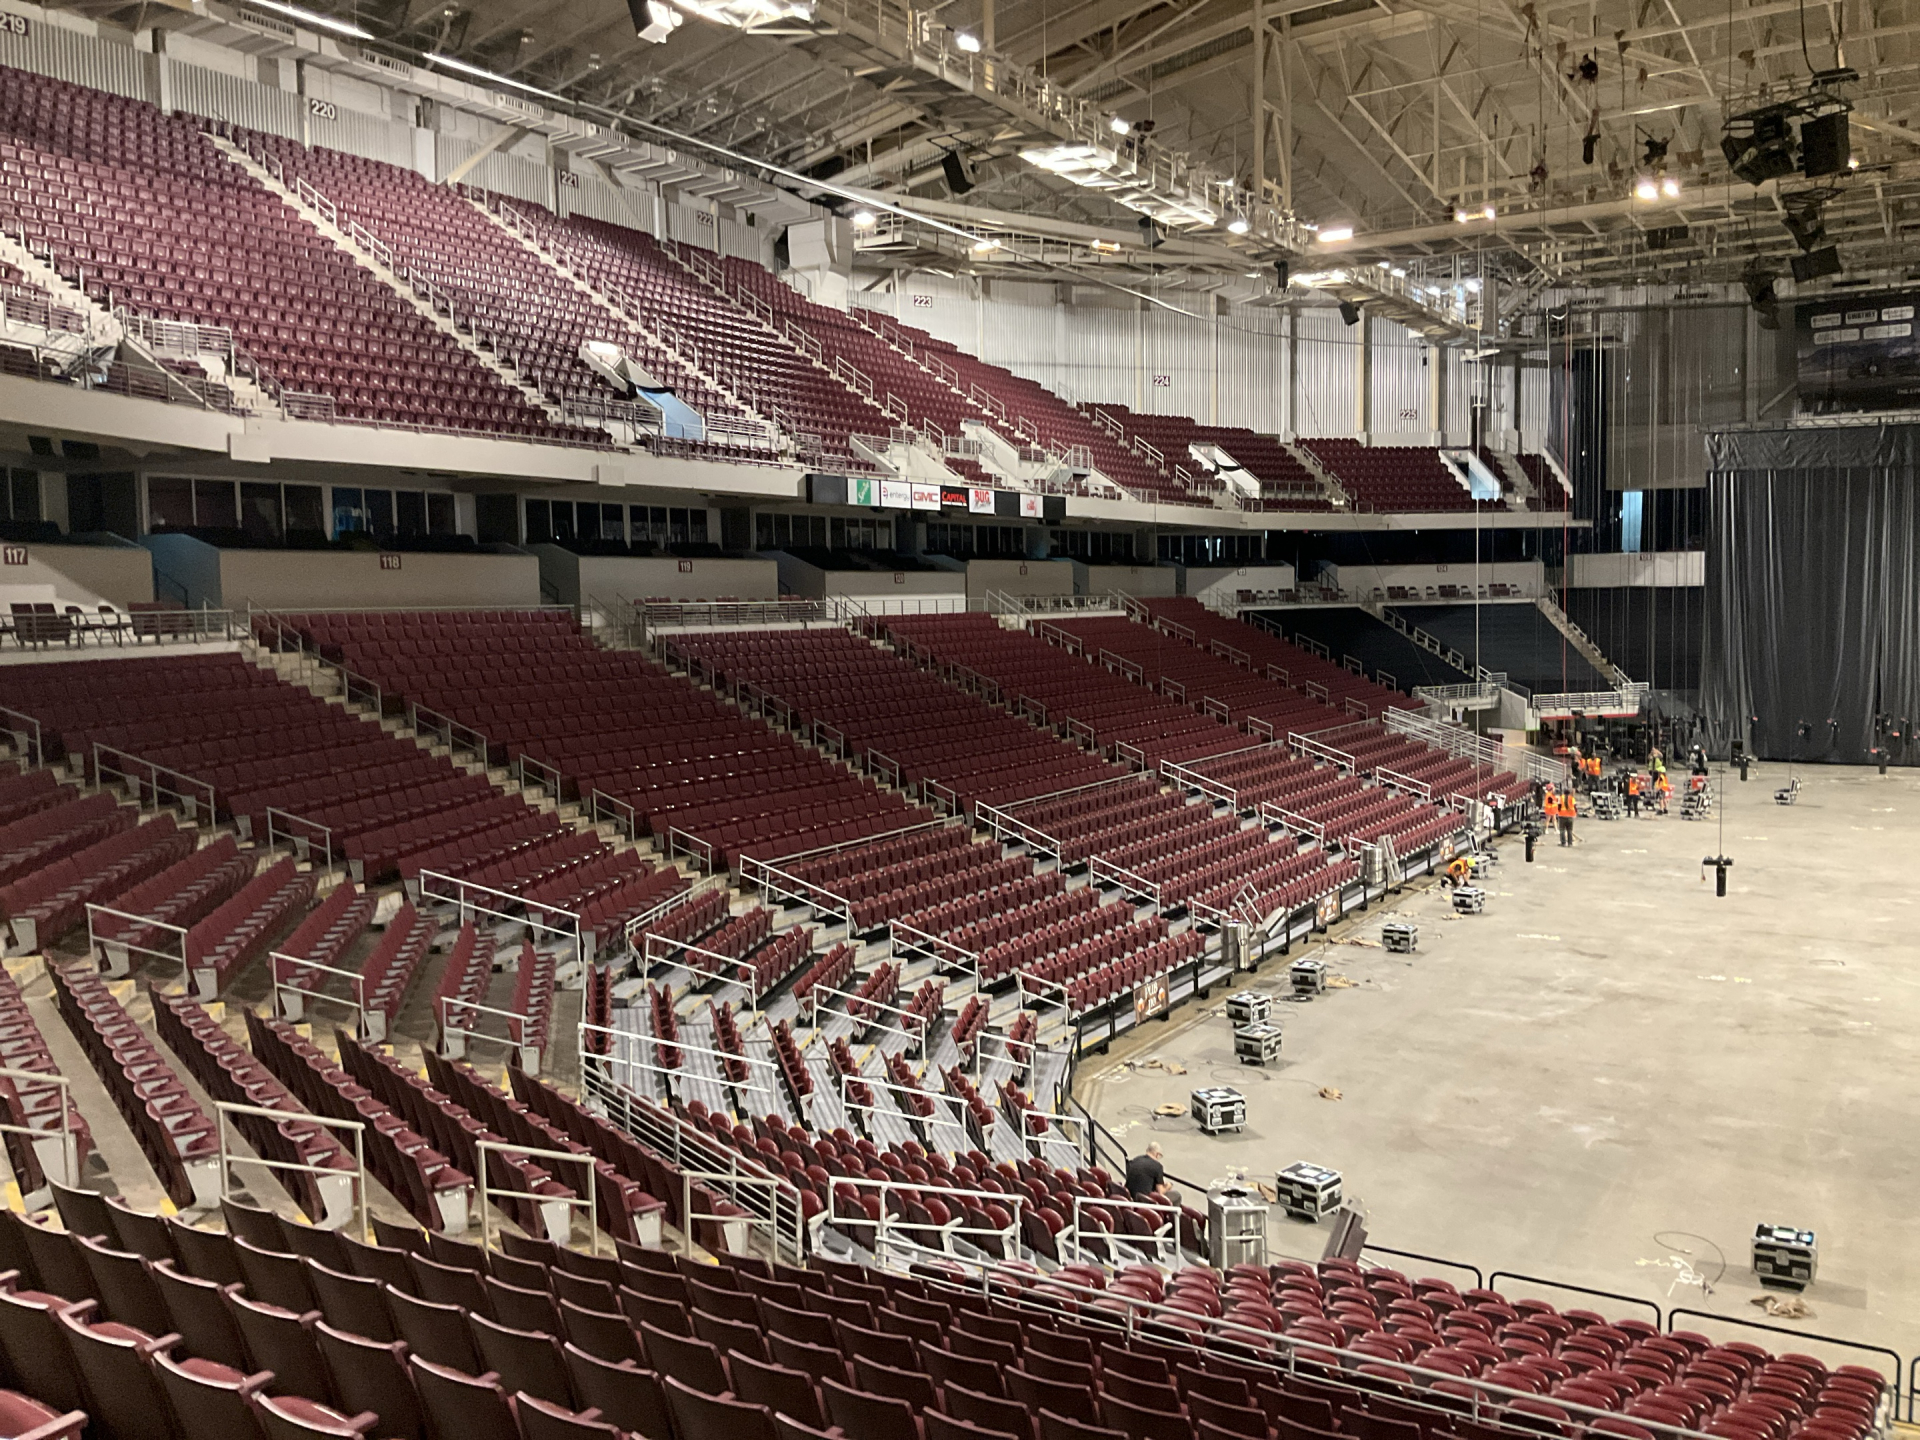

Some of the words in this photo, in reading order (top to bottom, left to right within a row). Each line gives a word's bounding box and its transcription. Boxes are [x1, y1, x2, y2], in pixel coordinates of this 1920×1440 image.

[0, 14, 26, 34] 219
[311, 100, 336, 119] 220
[561, 172, 577, 188] 221
[698, 212, 712, 225] 222
[914, 296, 931, 307] 223
[1154, 376, 1169, 386] 224
[1400, 410, 1416, 419] 225
[889, 492, 910, 502] entergy
[913, 492, 938, 502] GMC
[942, 492, 966, 503] CAPITAL
[6, 547, 25, 563] 117
[382, 556, 400, 568] 118
[680, 561, 691, 571] 119
[1145, 981, 1158, 999] PUB
